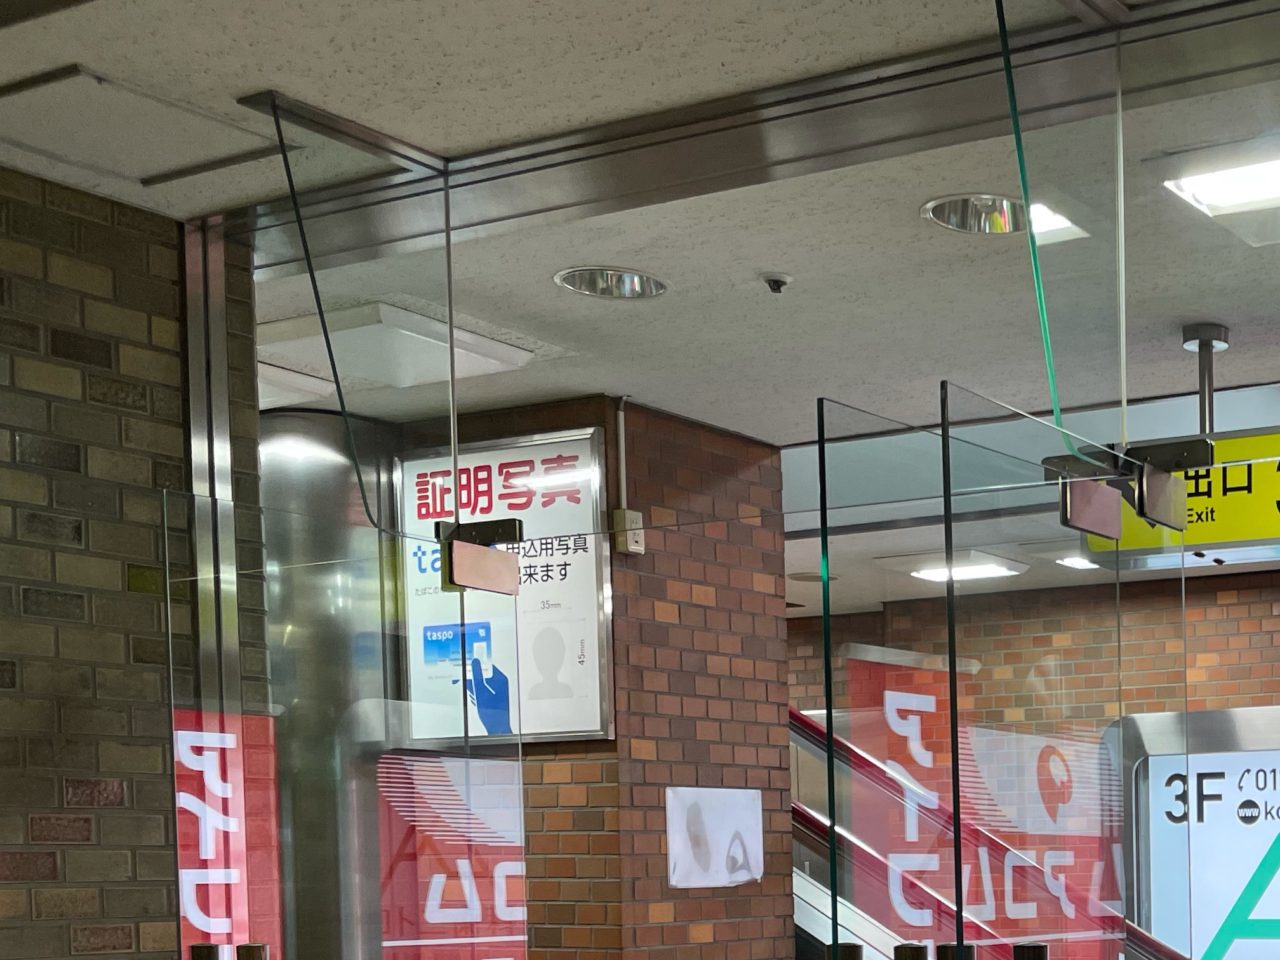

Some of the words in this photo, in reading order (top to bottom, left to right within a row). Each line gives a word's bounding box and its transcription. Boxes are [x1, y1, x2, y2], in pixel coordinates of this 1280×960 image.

[415, 454, 582, 520] 証明写真
[1184, 462, 1252, 498] 出口
[1187, 507, 1216, 524] Exit
[518, 561, 572, 586] 来ます
[426, 630, 454, 642] taspo
[1163, 771, 1226, 825] 3F
